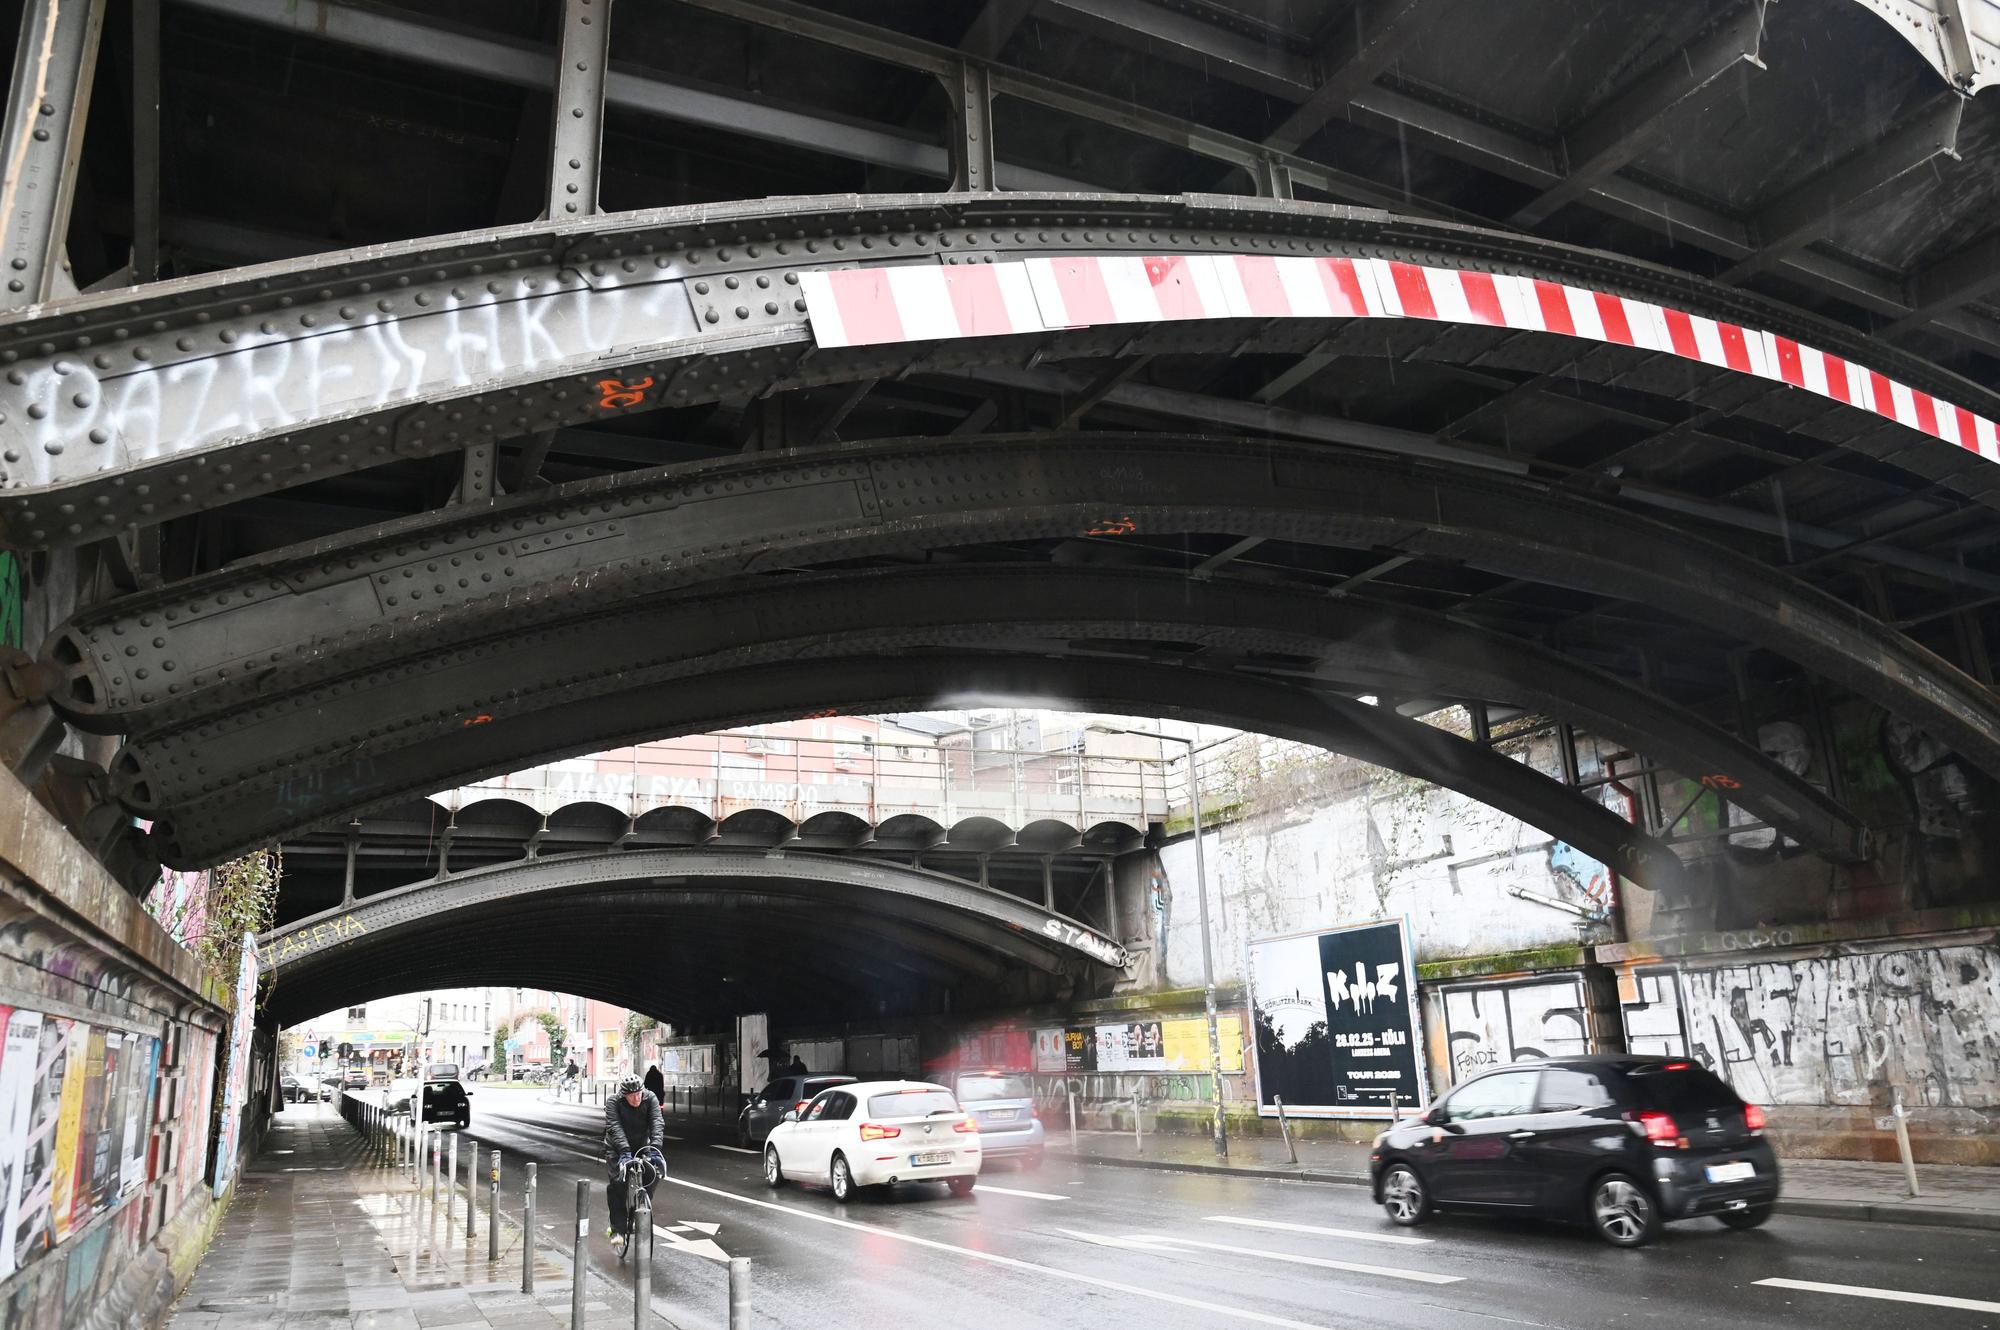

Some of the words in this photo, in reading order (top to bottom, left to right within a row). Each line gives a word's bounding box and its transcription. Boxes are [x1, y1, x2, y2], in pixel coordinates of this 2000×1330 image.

[732, 782, 819, 807] BAMBOO
[1381, 1028, 1406, 1046] KÖLN
[1346, 1071, 1373, 1080] TOUR
